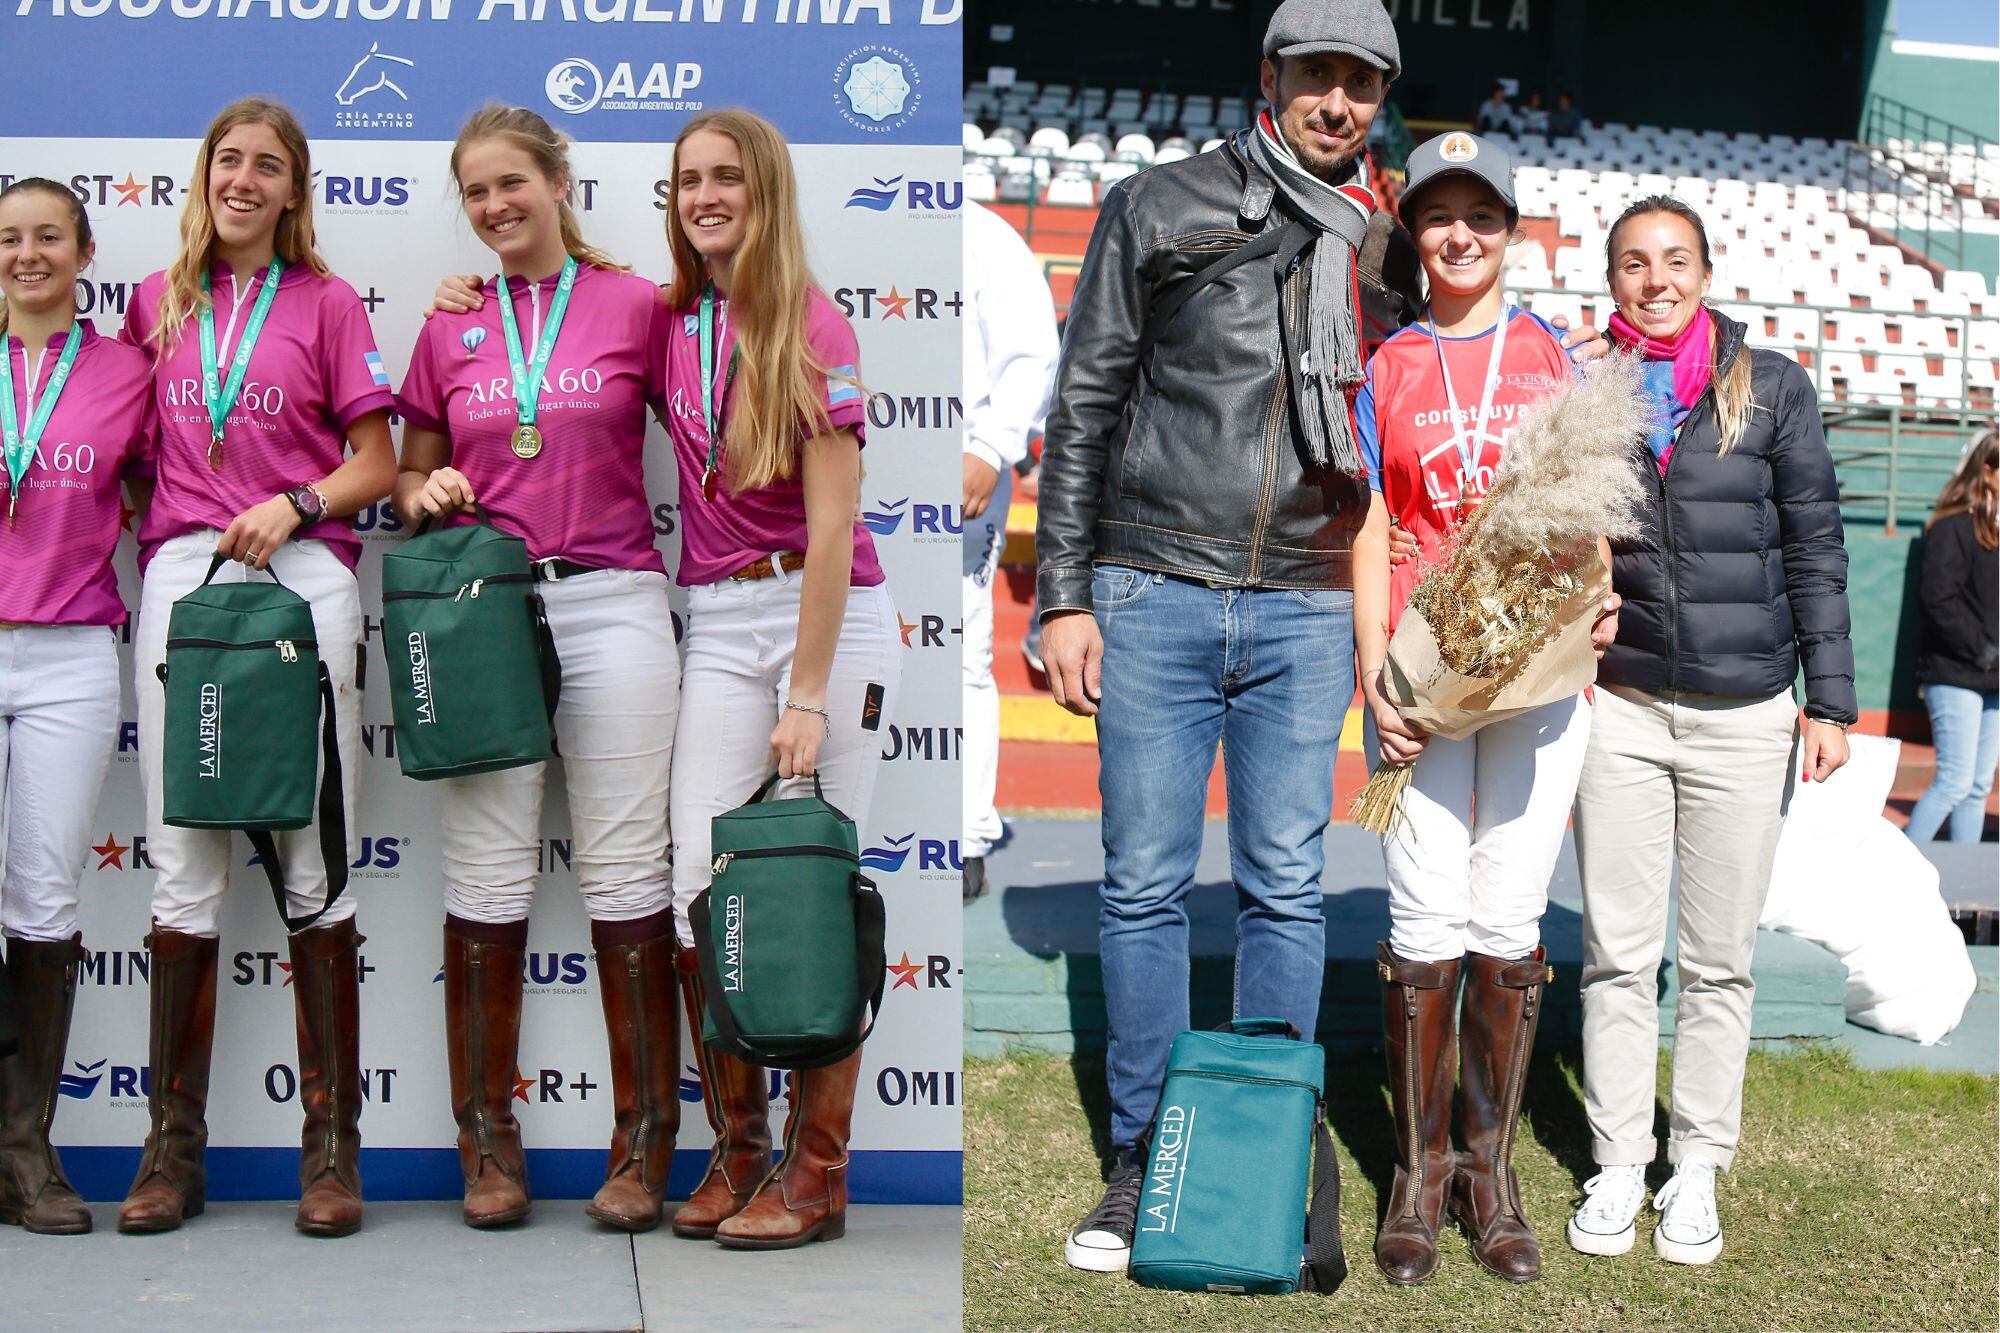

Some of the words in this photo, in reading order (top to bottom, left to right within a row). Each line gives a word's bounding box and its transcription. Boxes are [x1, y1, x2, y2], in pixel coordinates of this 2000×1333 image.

[601, 62, 702, 99] AAP
[377, 112, 413, 120] POLO
[639, 101, 674, 110] ARGENTINA
[675, 102, 684, 110] DE
[684, 102, 703, 111] POLO
[335, 120, 413, 128] ARGENTINO
[189, 415, 202, 423] en
[467, 409, 494, 422] Todo
[497, 407, 511, 416] en
[568, 398, 600, 410] único
[29, 477, 57, 491] lugar
[60, 477, 88, 490] único
[408, 631, 428, 700] MERCED
[199, 683, 218, 754] MERCED
[415, 701, 432, 725] LA
[199, 755, 215, 779] LA
[725, 894, 740, 966] MERCED
[724, 970, 740, 993] LA
[1149, 1105, 1186, 1197] MERCED
[1142, 1202, 1170, 1233] LA
